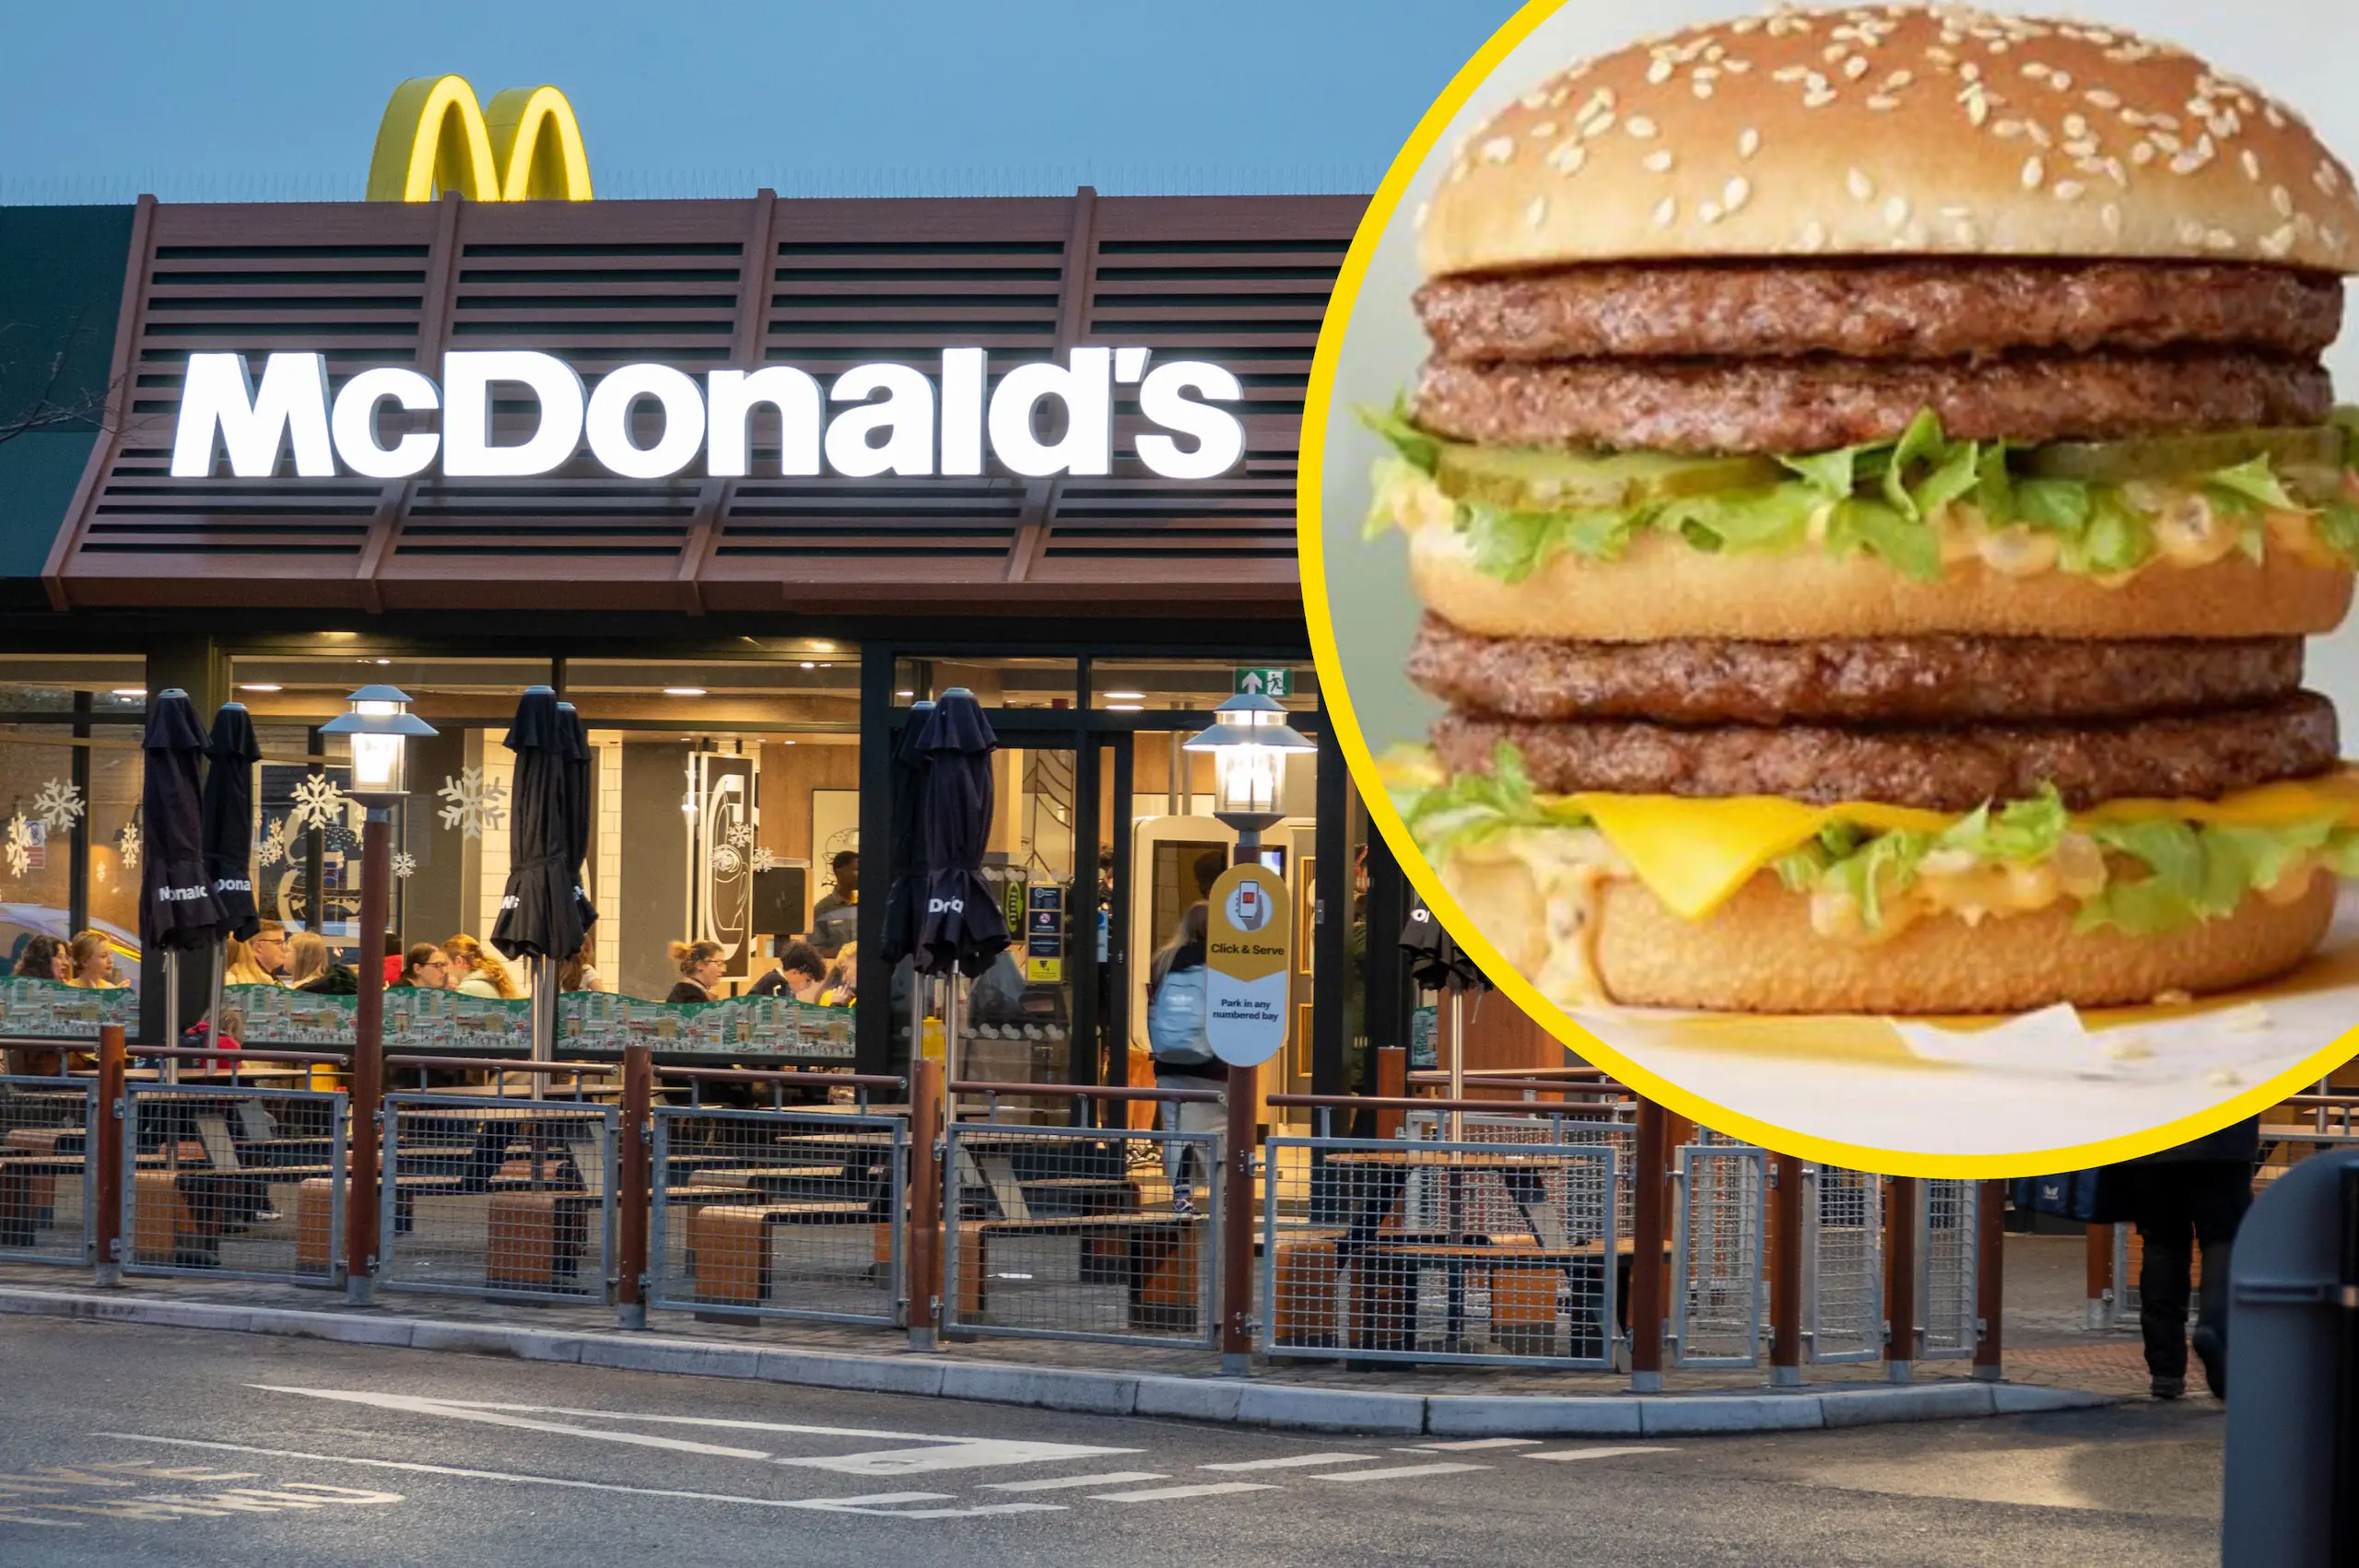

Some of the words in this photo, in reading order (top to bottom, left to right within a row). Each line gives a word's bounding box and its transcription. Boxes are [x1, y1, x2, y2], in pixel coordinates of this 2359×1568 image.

[170, 346, 1246, 479] McDonald's
[1211, 942, 1239, 954] Click
[1241, 944, 1250, 954] &
[1252, 944, 1285, 955] Serve
[1221, 999, 1242, 1008] Park
[1244, 999, 1252, 1008] in
[1254, 1001, 1271, 1011] any
[1213, 1011, 1260, 1020] numbered
[1262, 1012, 1278, 1023] bay
